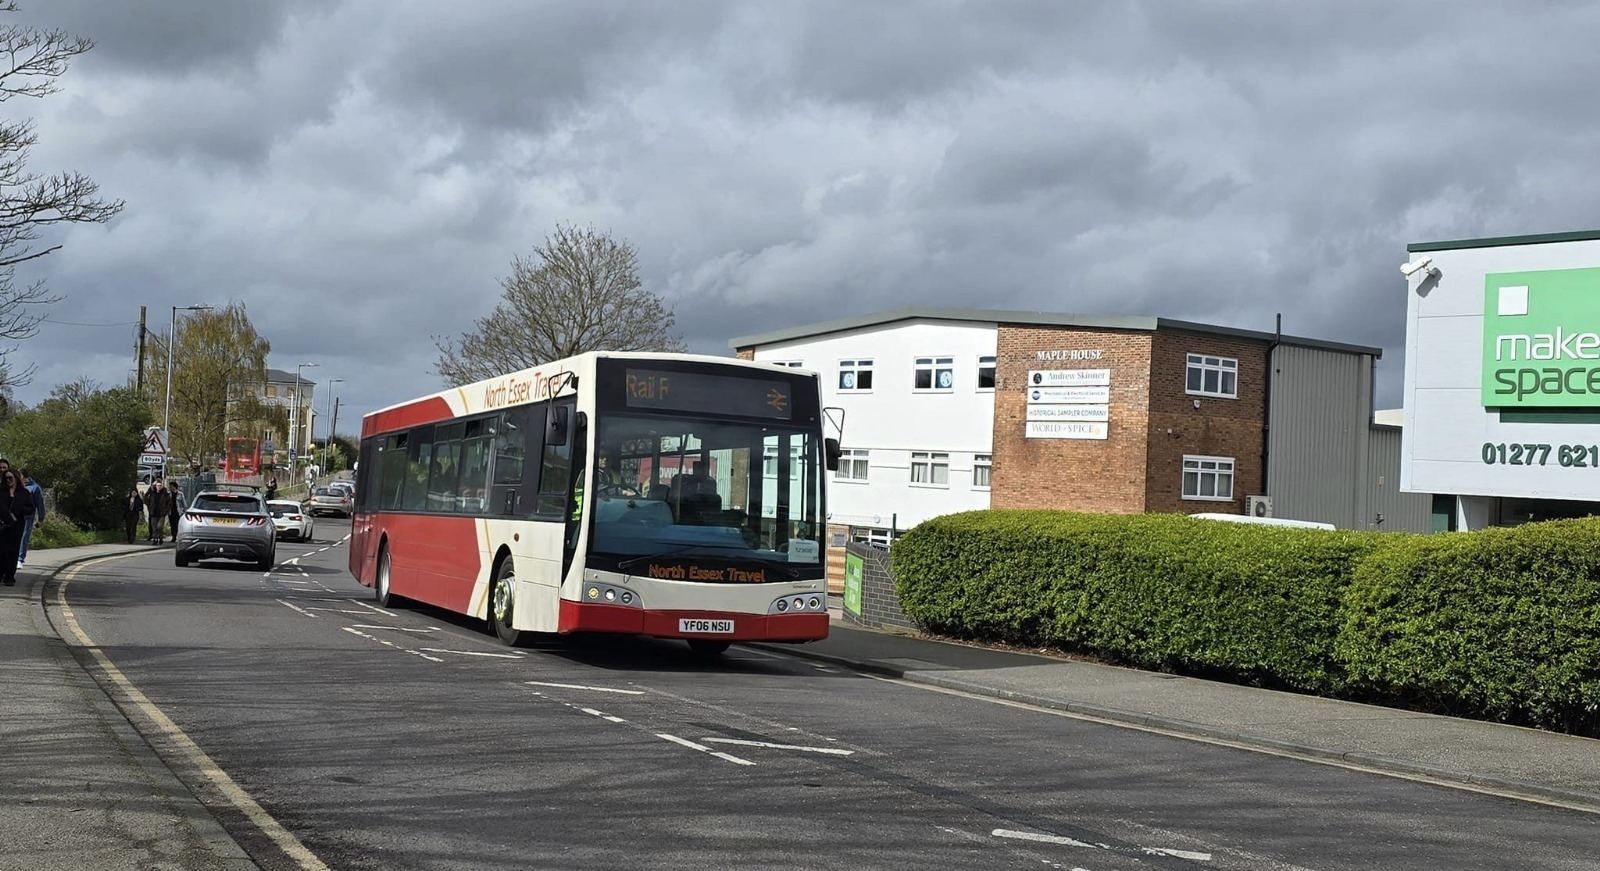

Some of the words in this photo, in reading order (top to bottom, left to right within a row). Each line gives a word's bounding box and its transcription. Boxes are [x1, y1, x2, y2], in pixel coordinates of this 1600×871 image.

[1496, 326, 1600, 361] make
[1037, 350, 1069, 360] MAPLE
[1070, 349, 1104, 360] HOUSE
[1047, 372, 1075, 380] Andrew
[1077, 371, 1106, 380] Skinner
[483, 381, 506, 409] North
[508, 378, 532, 404] Essex
[626, 374, 656, 399] Rail
[1029, 409, 1056, 417] HISTORICAL
[1057, 409, 1080, 417] SAMPLER
[1081, 409, 1106, 417] COMPANY
[1031, 424, 1060, 433] WORLD
[1067, 424, 1094, 433] SPICE
[1482, 443, 1551, 466] 01277
[1558, 444, 1599, 468] 621
[648, 564, 685, 579] North
[688, 566, 724, 580] Essex
[727, 567, 765, 582] Travel
[683, 620, 709, 631] YF06
[711, 621, 730, 632] NSU
